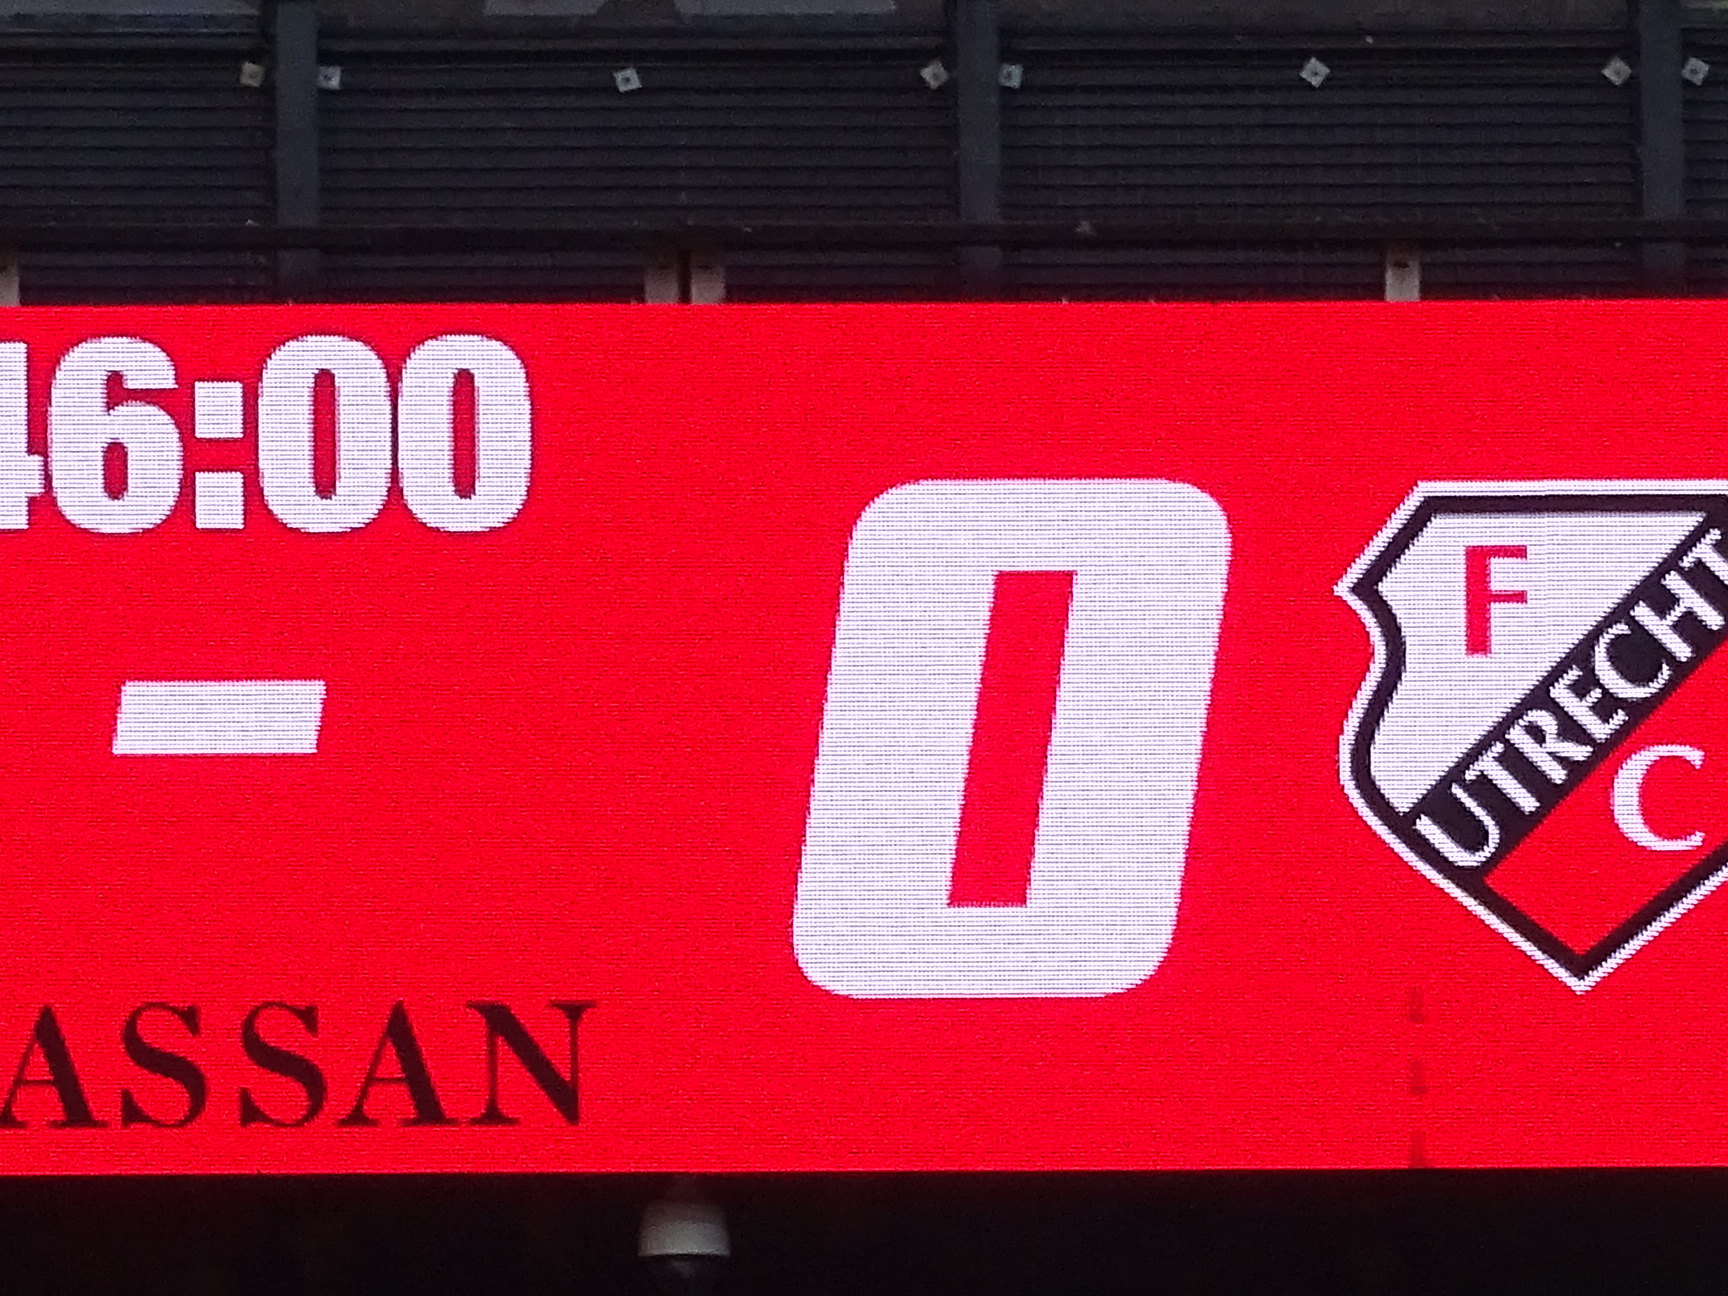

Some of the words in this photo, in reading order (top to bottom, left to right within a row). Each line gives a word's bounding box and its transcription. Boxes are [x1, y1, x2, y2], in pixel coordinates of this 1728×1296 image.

[1464, 545, 1528, 656] F
[792, 478, 1233, 1000] 0
[1611, 744, 1706, 851] C
